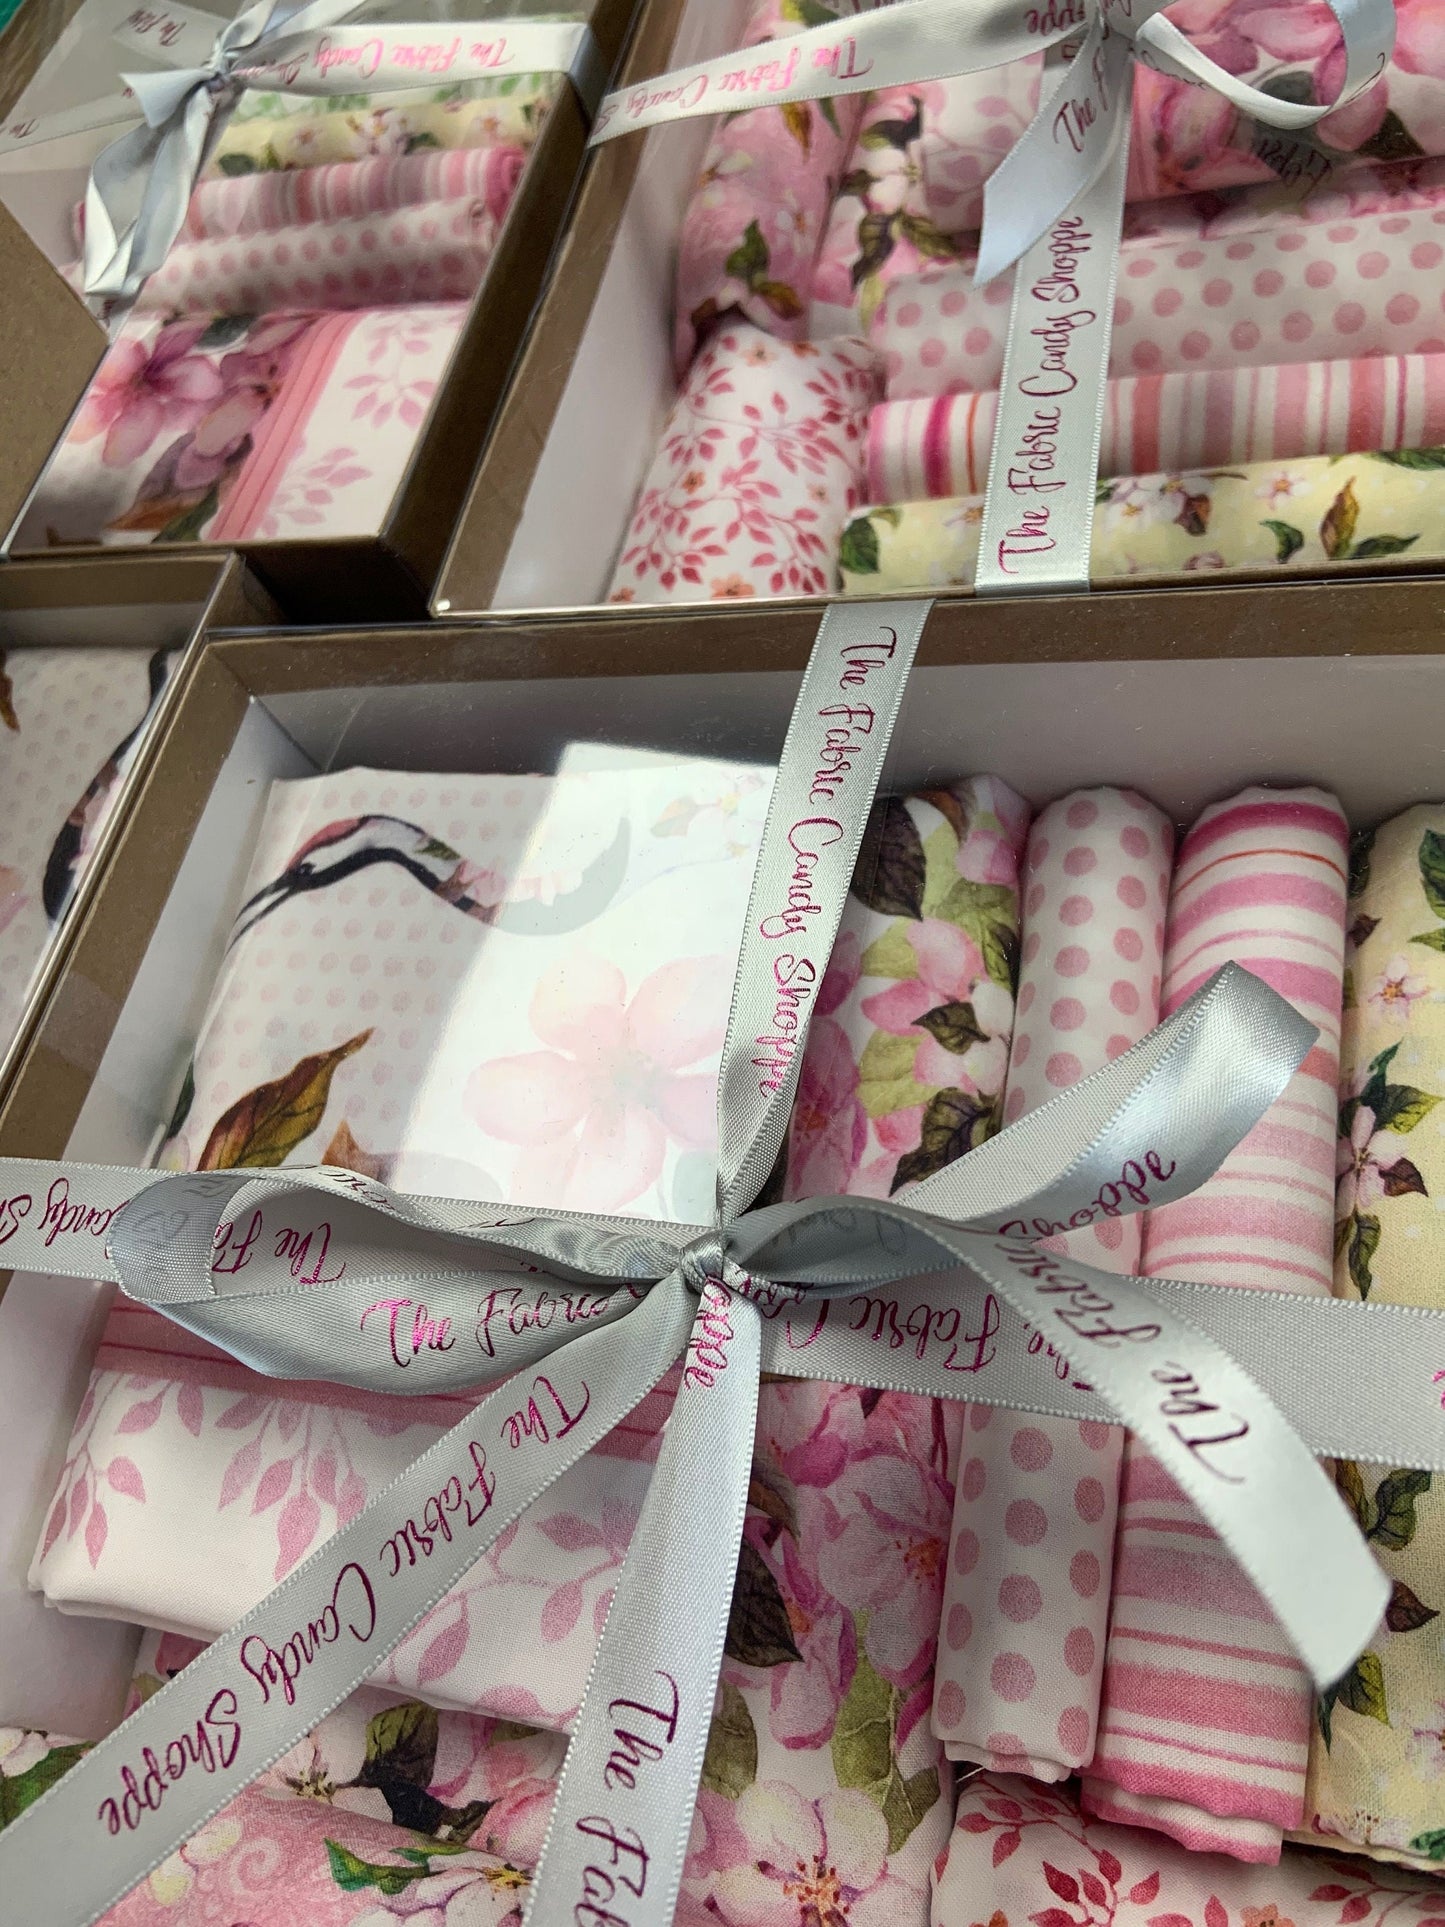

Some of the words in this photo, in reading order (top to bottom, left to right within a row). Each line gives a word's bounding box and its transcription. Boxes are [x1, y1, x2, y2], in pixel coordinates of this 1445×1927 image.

[312, 36, 384, 79] Candy
[469, 37, 515, 68] The
[812, 36, 874, 79] The
[1023, 0, 1085, 36] ppe
[626, 74, 709, 118] Candy
[717, 47, 798, 91] Fabric
[1052, 97, 1097, 153] The
[1030, 215, 1093, 303] Shoppe
[1018, 310, 1097, 397] Candy
[1007, 406, 1067, 496] Fabric
[997, 505, 1056, 575] The
[838, 624, 898, 690] The
[808, 702, 876, 806] Fabric
[759, 817, 844, 940] Candy
[751, 951, 818, 1100] Shoppe
[37, 1177, 130, 1259] andy
[211, 1209, 263, 1274] Fa
[274, 1222, 346, 1286] The
[360, 1298, 456, 1368] The
[475, 1287, 612, 1357] Fabric
[850, 1292, 1001, 1373] Fabric
[501, 1375, 590, 1448] The
[1150, 1360, 1250, 1484] The
[379, 1441, 497, 1577] Fabric
[240, 1562, 376, 1705] Candy
[97, 1689, 241, 1835] Shoppe
[604, 1668, 681, 1792] The
